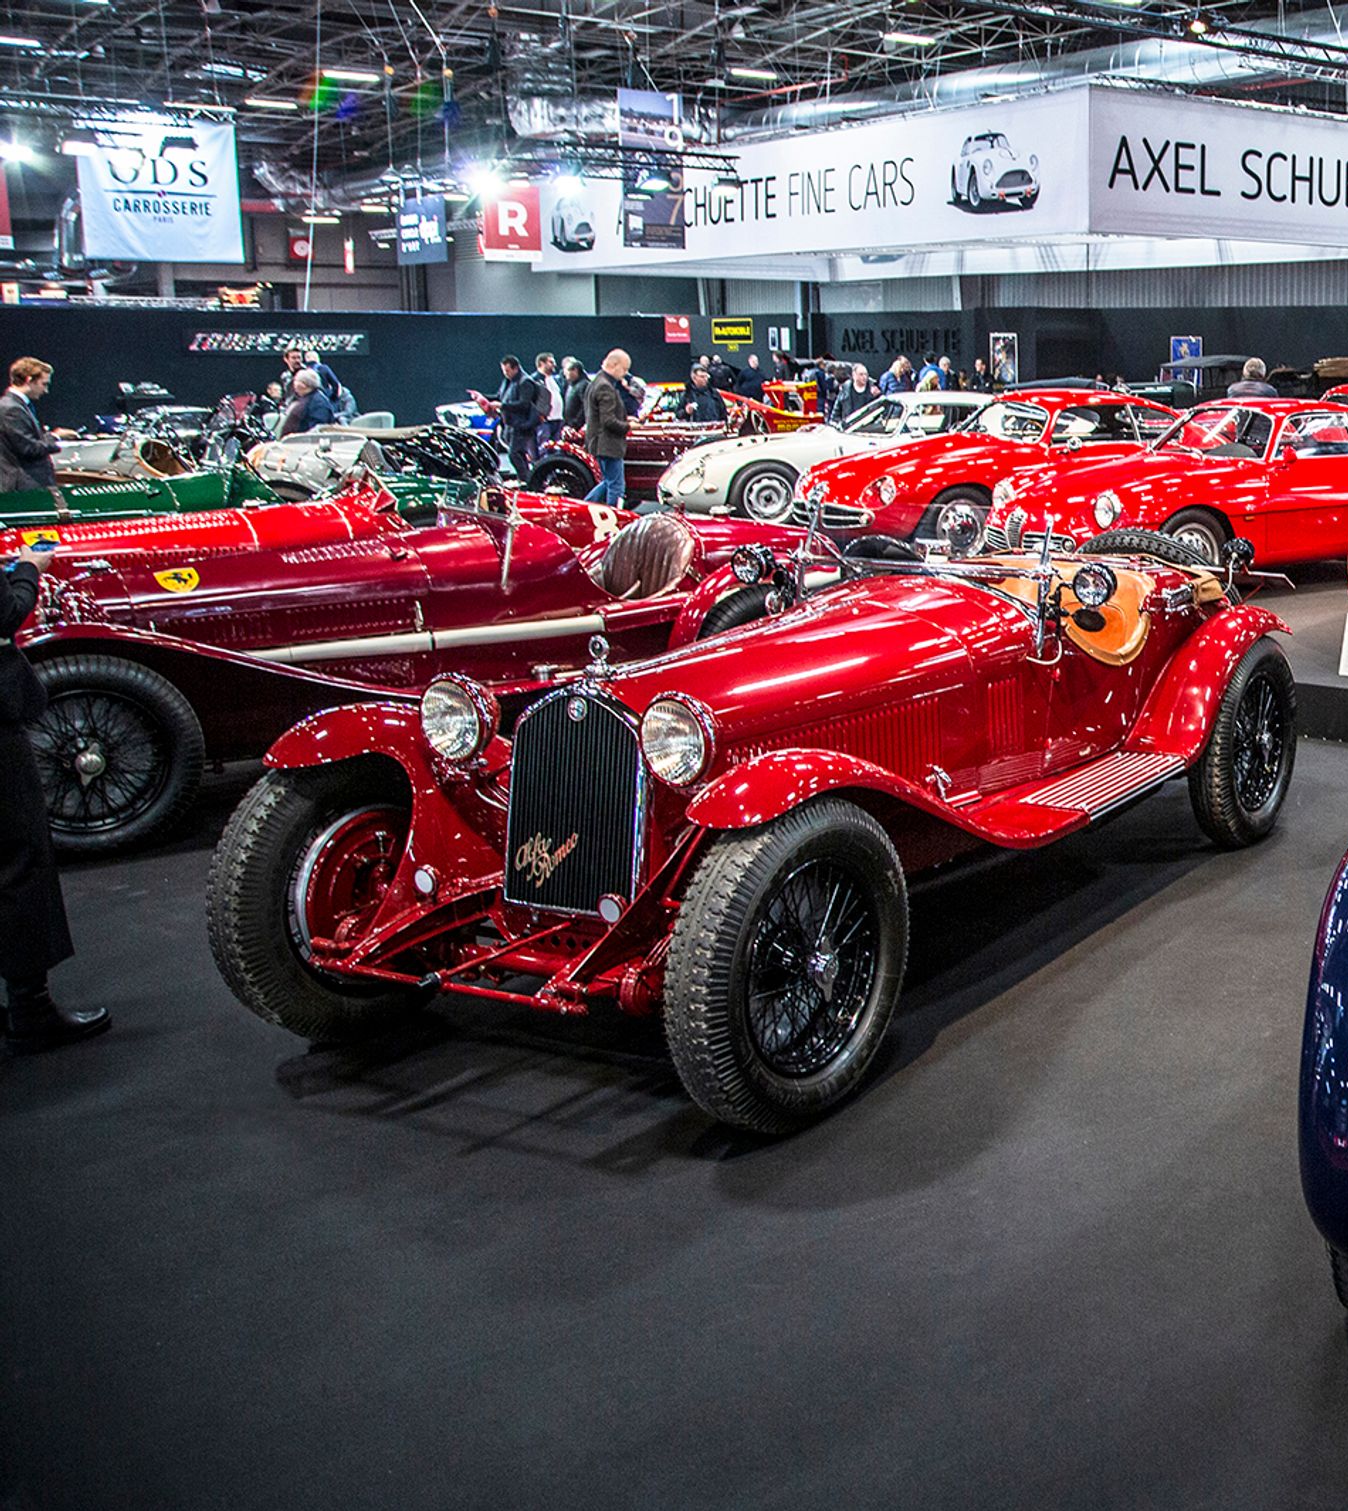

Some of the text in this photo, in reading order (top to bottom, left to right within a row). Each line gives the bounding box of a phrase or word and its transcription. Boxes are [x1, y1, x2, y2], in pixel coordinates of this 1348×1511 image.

[1108, 134, 1222, 198] AXEL
[113, 198, 212, 216] CARROSSERIE
[683, 176, 776, 228] CHUETTE
[788, 167, 836, 217] FINE
[848, 157, 915, 211] CARS
[499, 201, 529, 236] R
[841, 328, 879, 353] AXEL
[514, 832, 552, 880] Alfa
